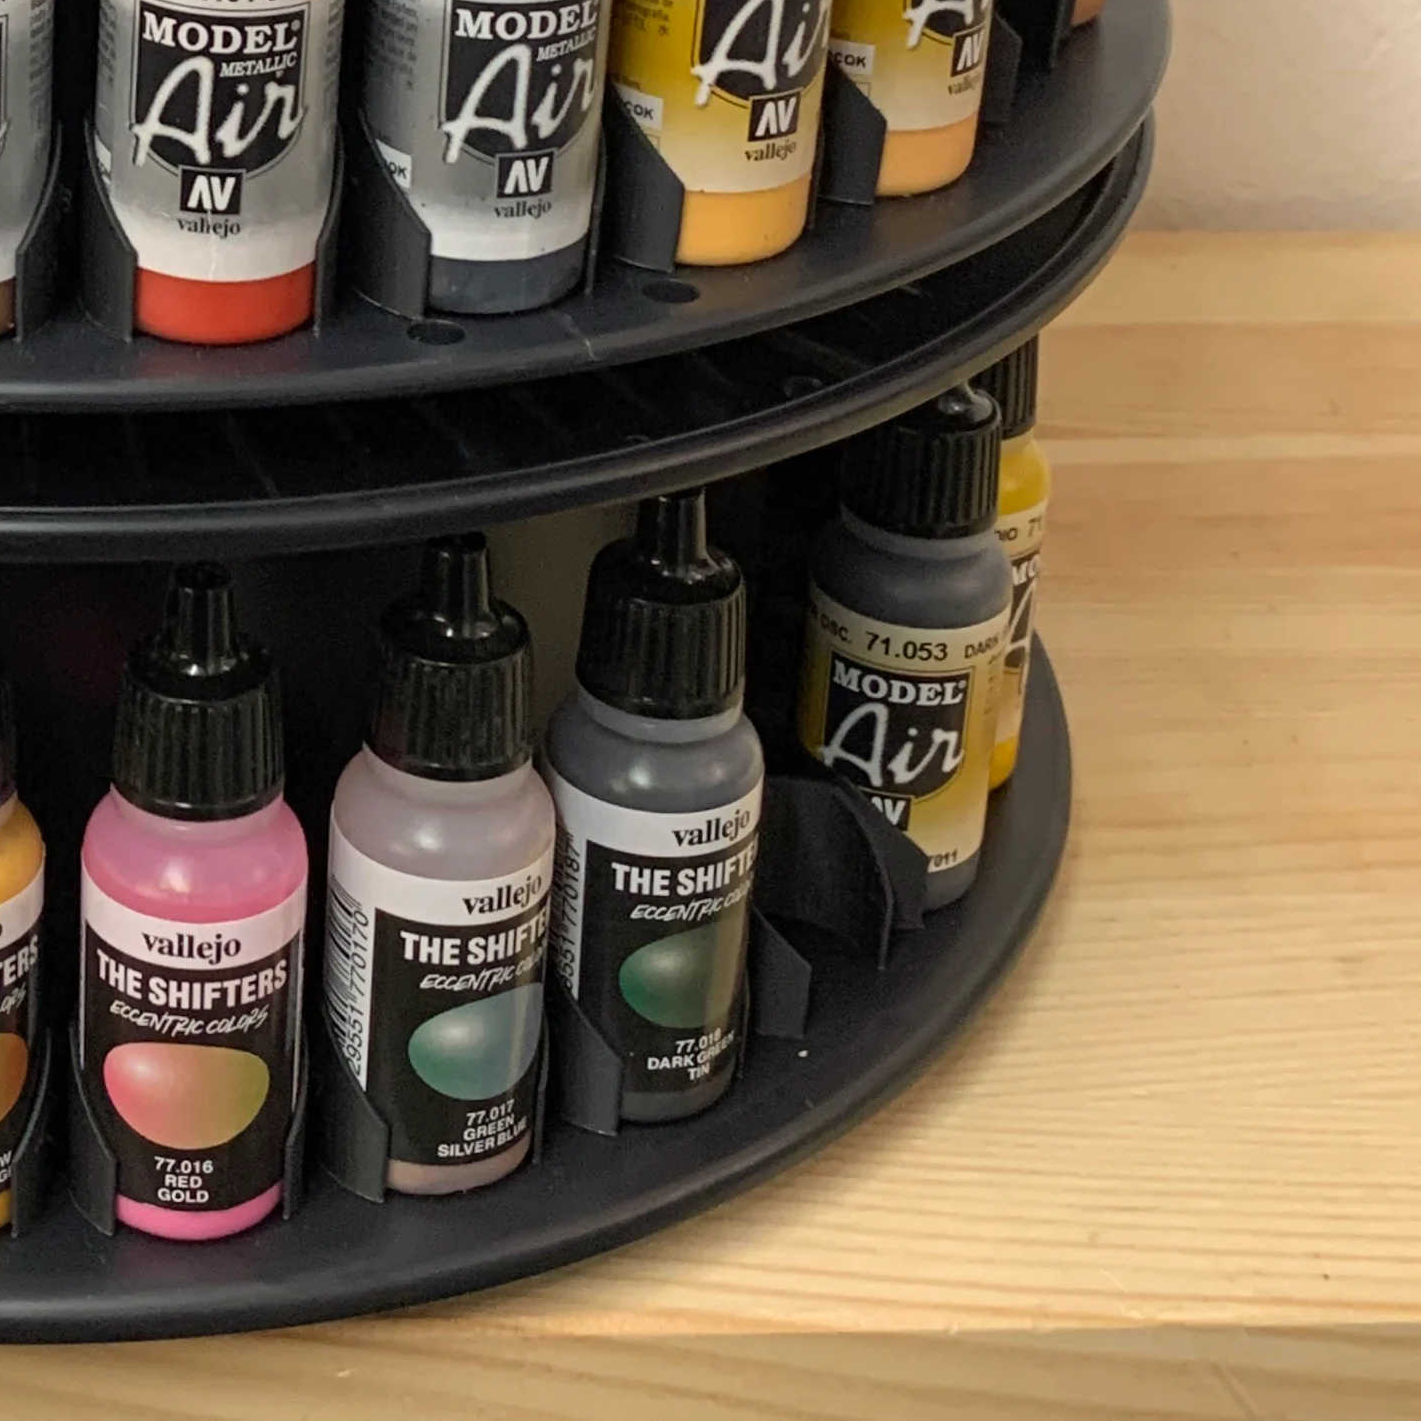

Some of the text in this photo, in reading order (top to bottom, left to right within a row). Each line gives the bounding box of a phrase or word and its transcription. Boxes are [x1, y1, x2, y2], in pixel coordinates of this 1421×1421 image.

[141, 10, 299, 55] MODEL
[453, 2, 599, 42] MODEL
[535, 26, 596, 62] METALLIC
[219, 50, 299, 78] METALLIC
[131, 54, 306, 166] Air
[438, 43, 595, 165] Air
[744, 141, 797, 164] vallejo
[494, 198, 552, 221] vallejo
[177, 215, 242, 239] vallejo
[865, 629, 949, 662] 71.053
[964, 631, 999, 660] DARK
[832, 659, 964, 707] MODEL
[820, 702, 966, 788] Air
[672, 808, 751, 848] vallejo
[610, 861, 670, 896] THE
[462, 875, 542, 917] vallejo
[630, 894, 722, 922] ECCENTRIC
[141, 931, 242, 966] vallejo
[400, 930, 461, 966] THE
[467, 908, 549, 967] SHIFTE
[96, 948, 288, 1010] THE SHIFTERS
[419, 964, 516, 992] ECCENTRIC
[109, 999, 270, 1037] ECCENTRIC COLORS
[675, 1028, 722, 1055] 77.018
[647, 1054, 695, 1071] DARK
[687, 1064, 711, 1082] TIN
[463, 1112, 516, 1141] GREEN
[465, 1099, 514, 1126] 77.017
[437, 1117, 528, 1158] SILVER BLUE
[154, 1155, 214, 1175] 77.016
[164, 1174, 203, 1189] RED
[157, 1188, 210, 1204] GOLD
